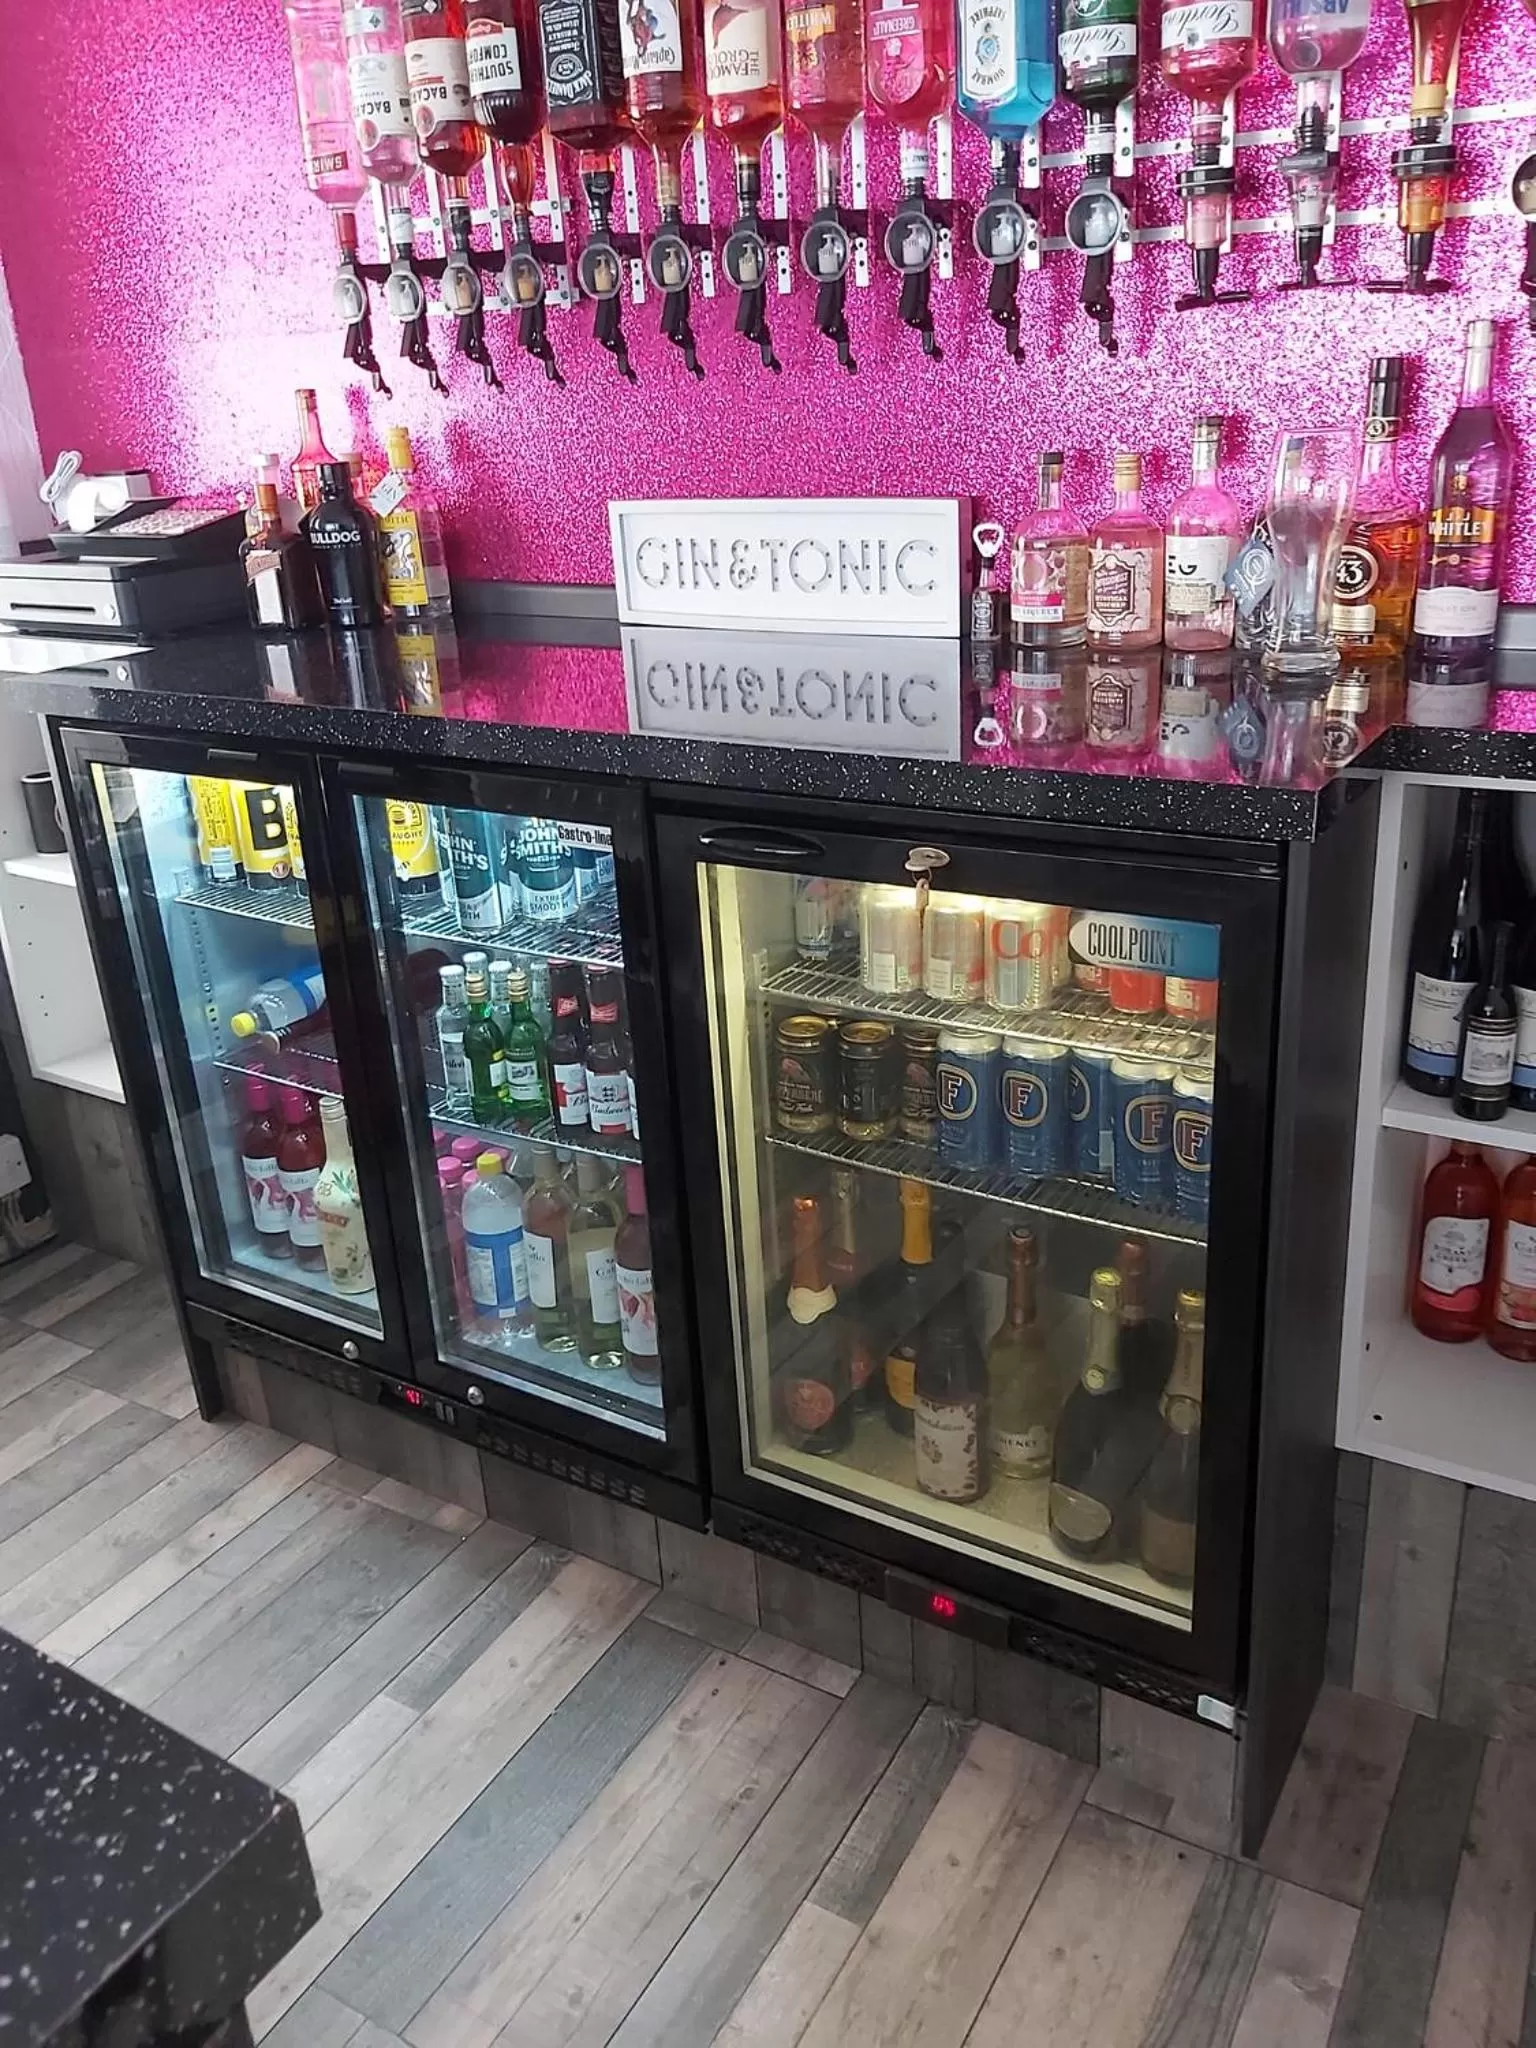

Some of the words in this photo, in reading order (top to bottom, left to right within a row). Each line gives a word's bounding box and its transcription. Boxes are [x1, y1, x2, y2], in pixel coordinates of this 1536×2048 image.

[572, 70, 593, 95] JACK
[1088, 922, 1178, 967] COOLPOINT
[941, 1073, 963, 1110] F
[1009, 1078, 1033, 1117] F
[1139, 1104, 1167, 1144] F
[1182, 1120, 1208, 1162] F
